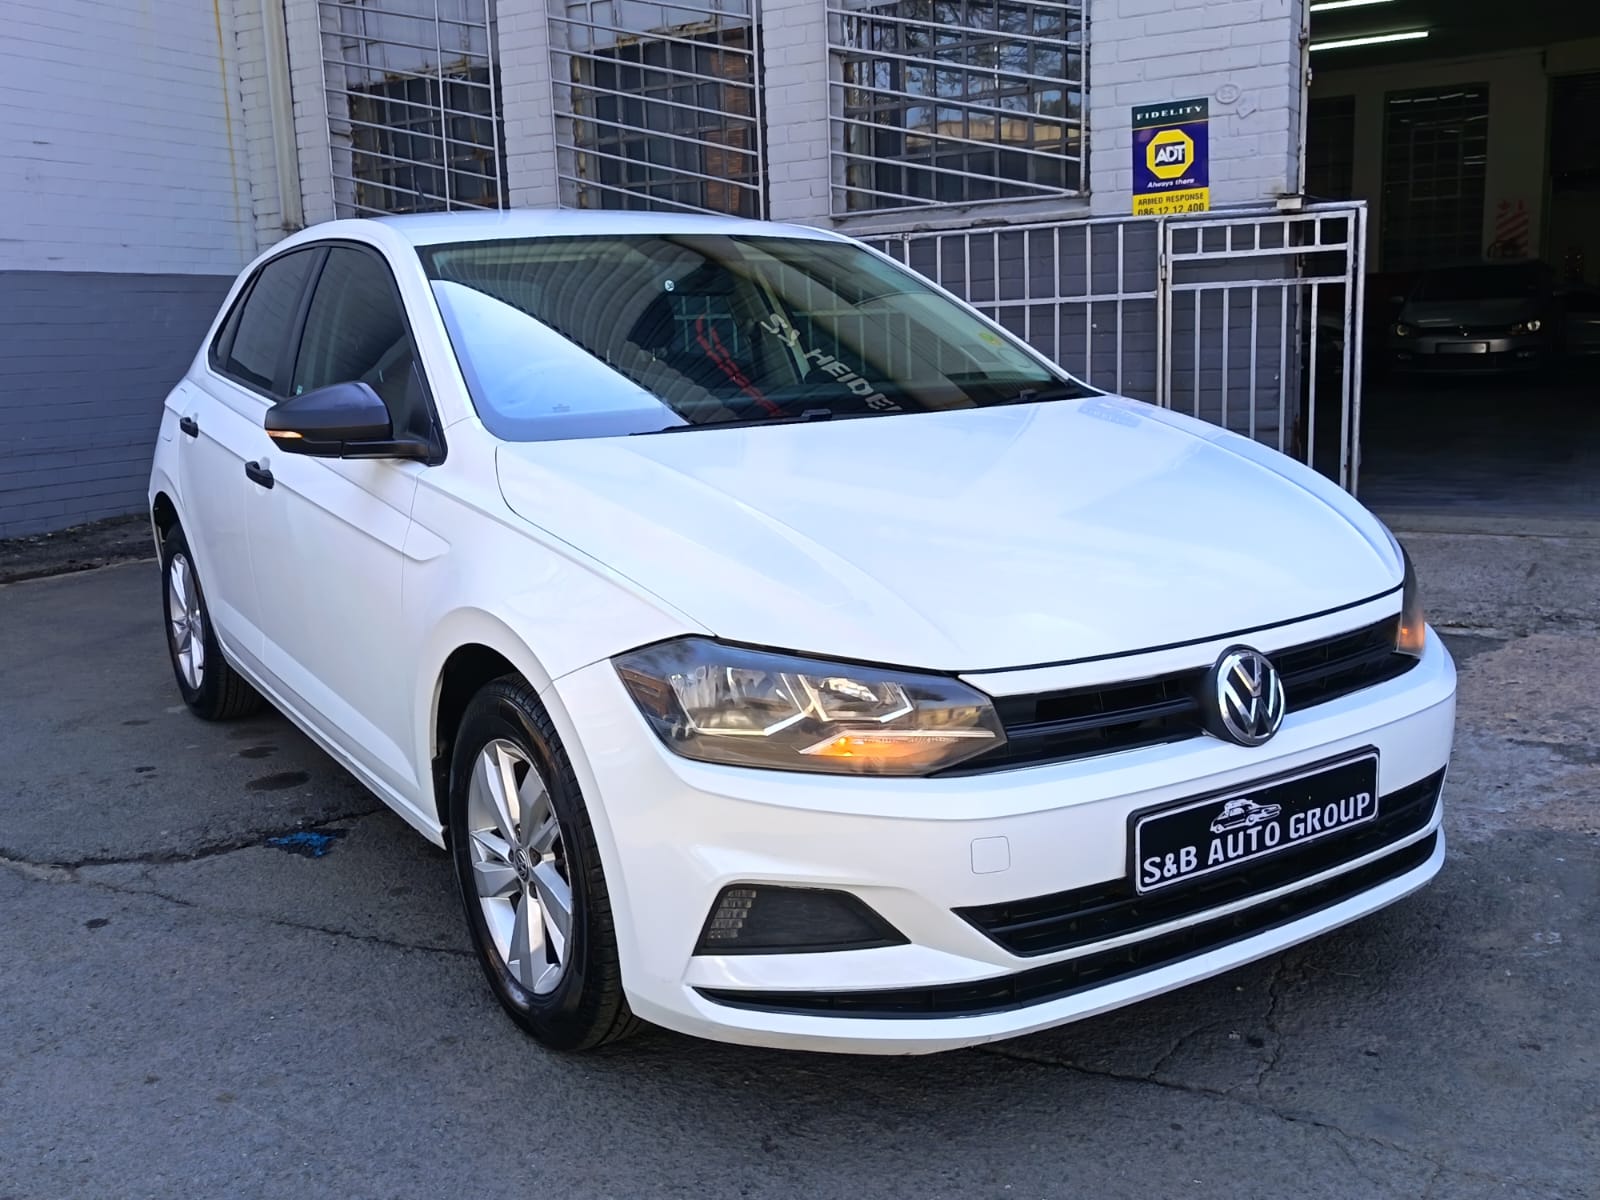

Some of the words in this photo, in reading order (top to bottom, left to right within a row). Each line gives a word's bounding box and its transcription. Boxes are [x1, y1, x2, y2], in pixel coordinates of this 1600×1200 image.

[1136, 105, 1202, 121] FIDELITY
[1155, 144, 1185, 164] ADT
[1147, 180, 1173, 189] Always
[1138, 197, 1163, 206] ARMED
[1166, 192, 1204, 203] RESPONSE
[1159, 206, 1169, 215] 12
[1173, 204, 1184, 214] 12
[1188, 202, 1205, 213] 400
[1143, 845, 1198, 884] S&B
[1208, 820, 1281, 866] AUTO
[1289, 792, 1371, 840] GROUP
